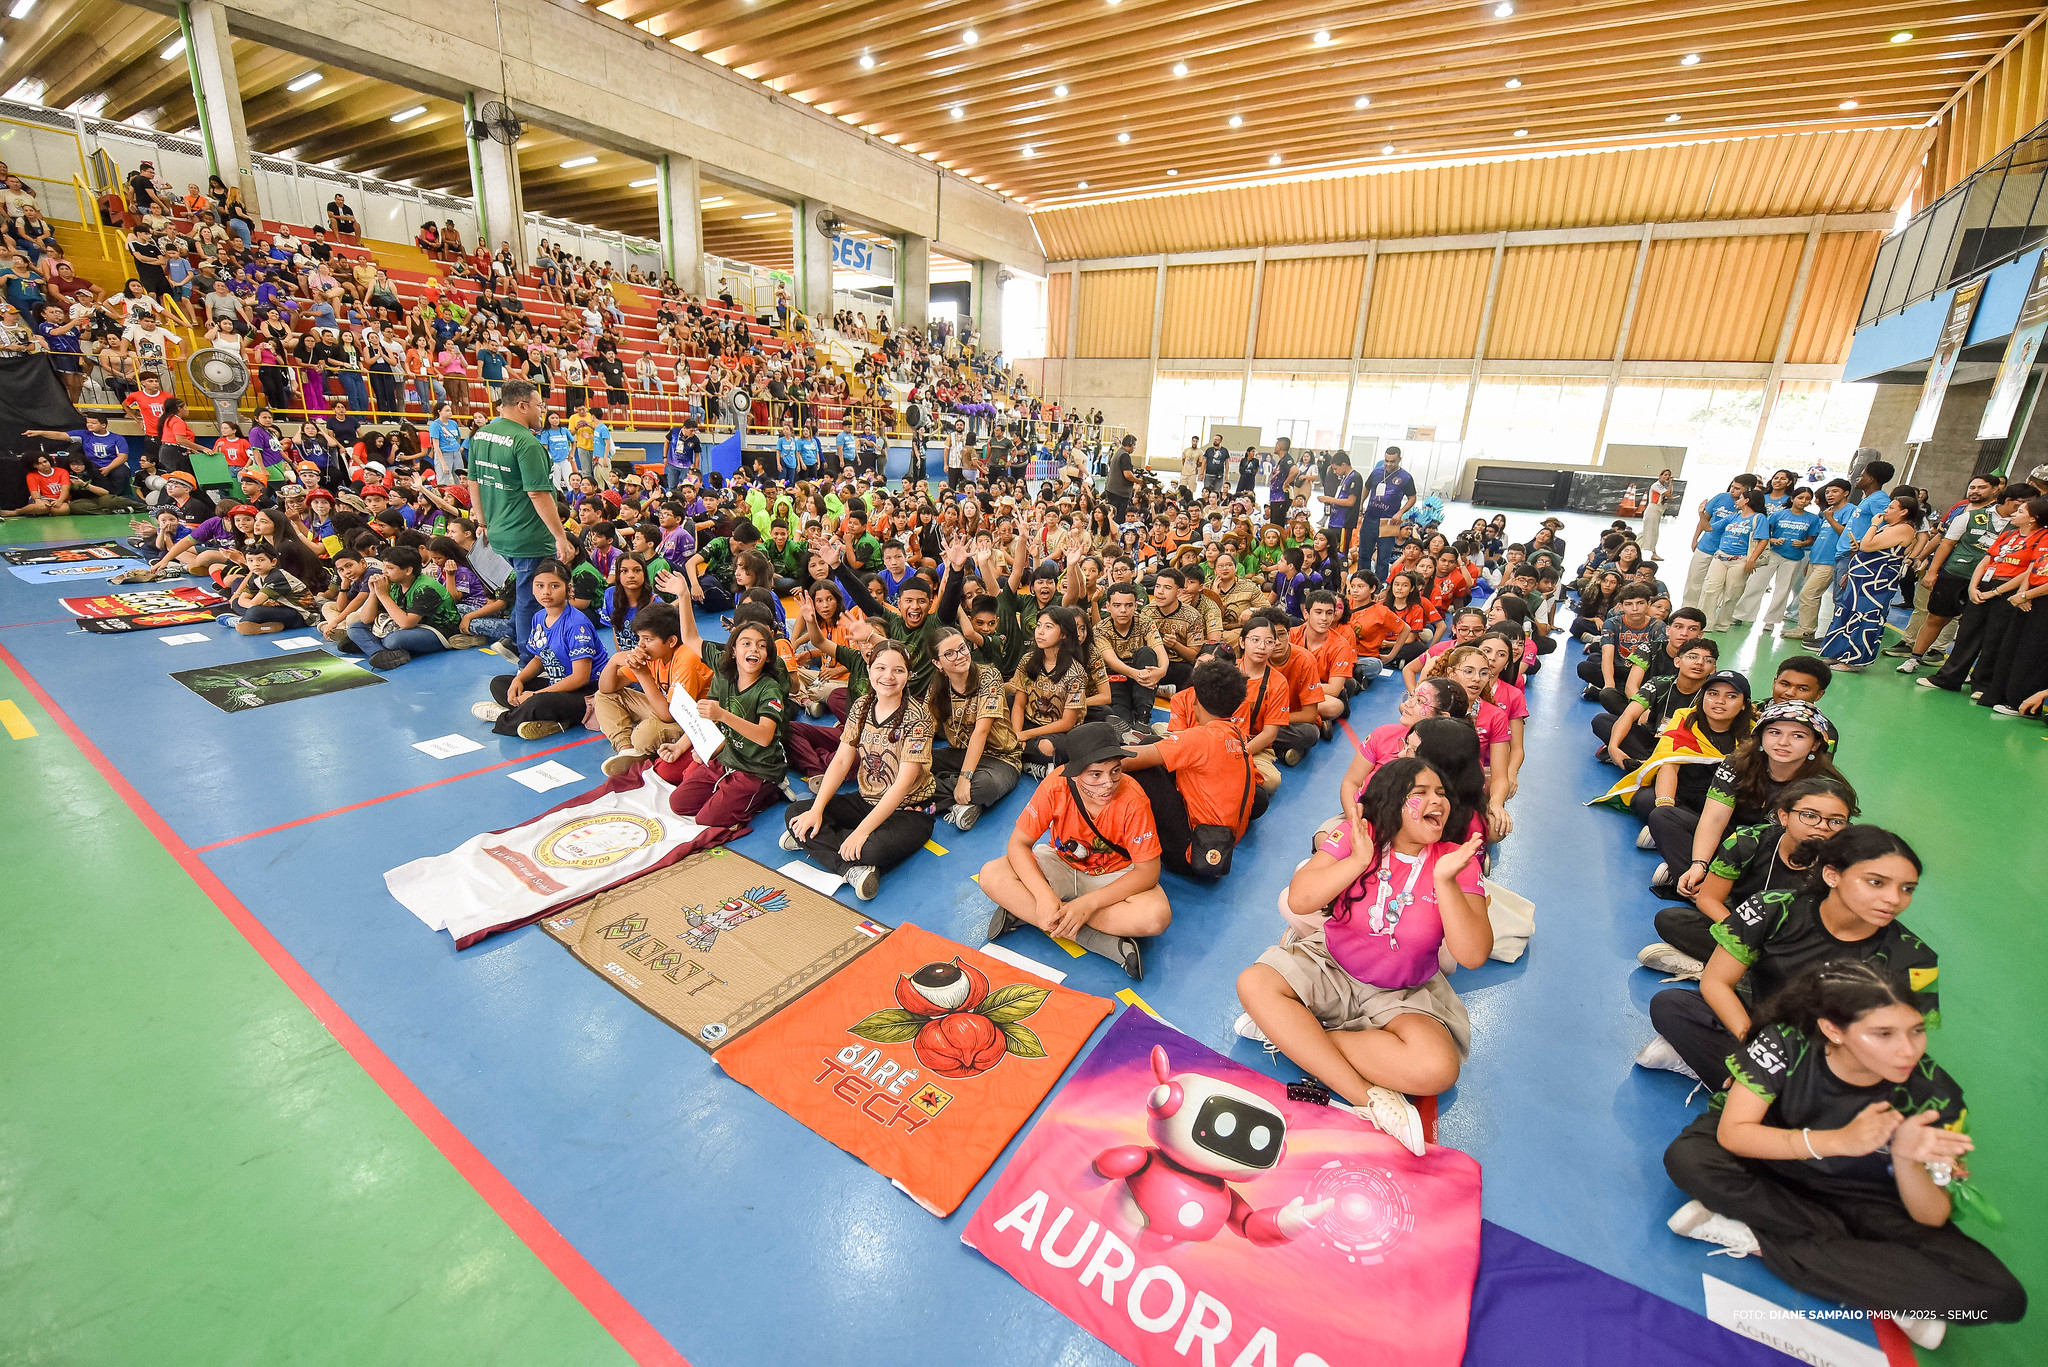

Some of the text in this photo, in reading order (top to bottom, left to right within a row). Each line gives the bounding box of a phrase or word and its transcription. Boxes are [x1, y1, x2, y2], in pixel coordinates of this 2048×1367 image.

[1619, 630, 1650, 643] FÊNIX
[1715, 767, 1736, 783] ESI
[571, 817, 608, 829] CENTRO
[581, 856, 611, 867] 82/09
[1735, 900, 1763, 926] ESI
[603, 962, 627, 977] SESI
[834, 1042, 919, 1096] BARÉ
[813, 1057, 930, 1135] TECH
[993, 1190, 1331, 1367] AURORA
